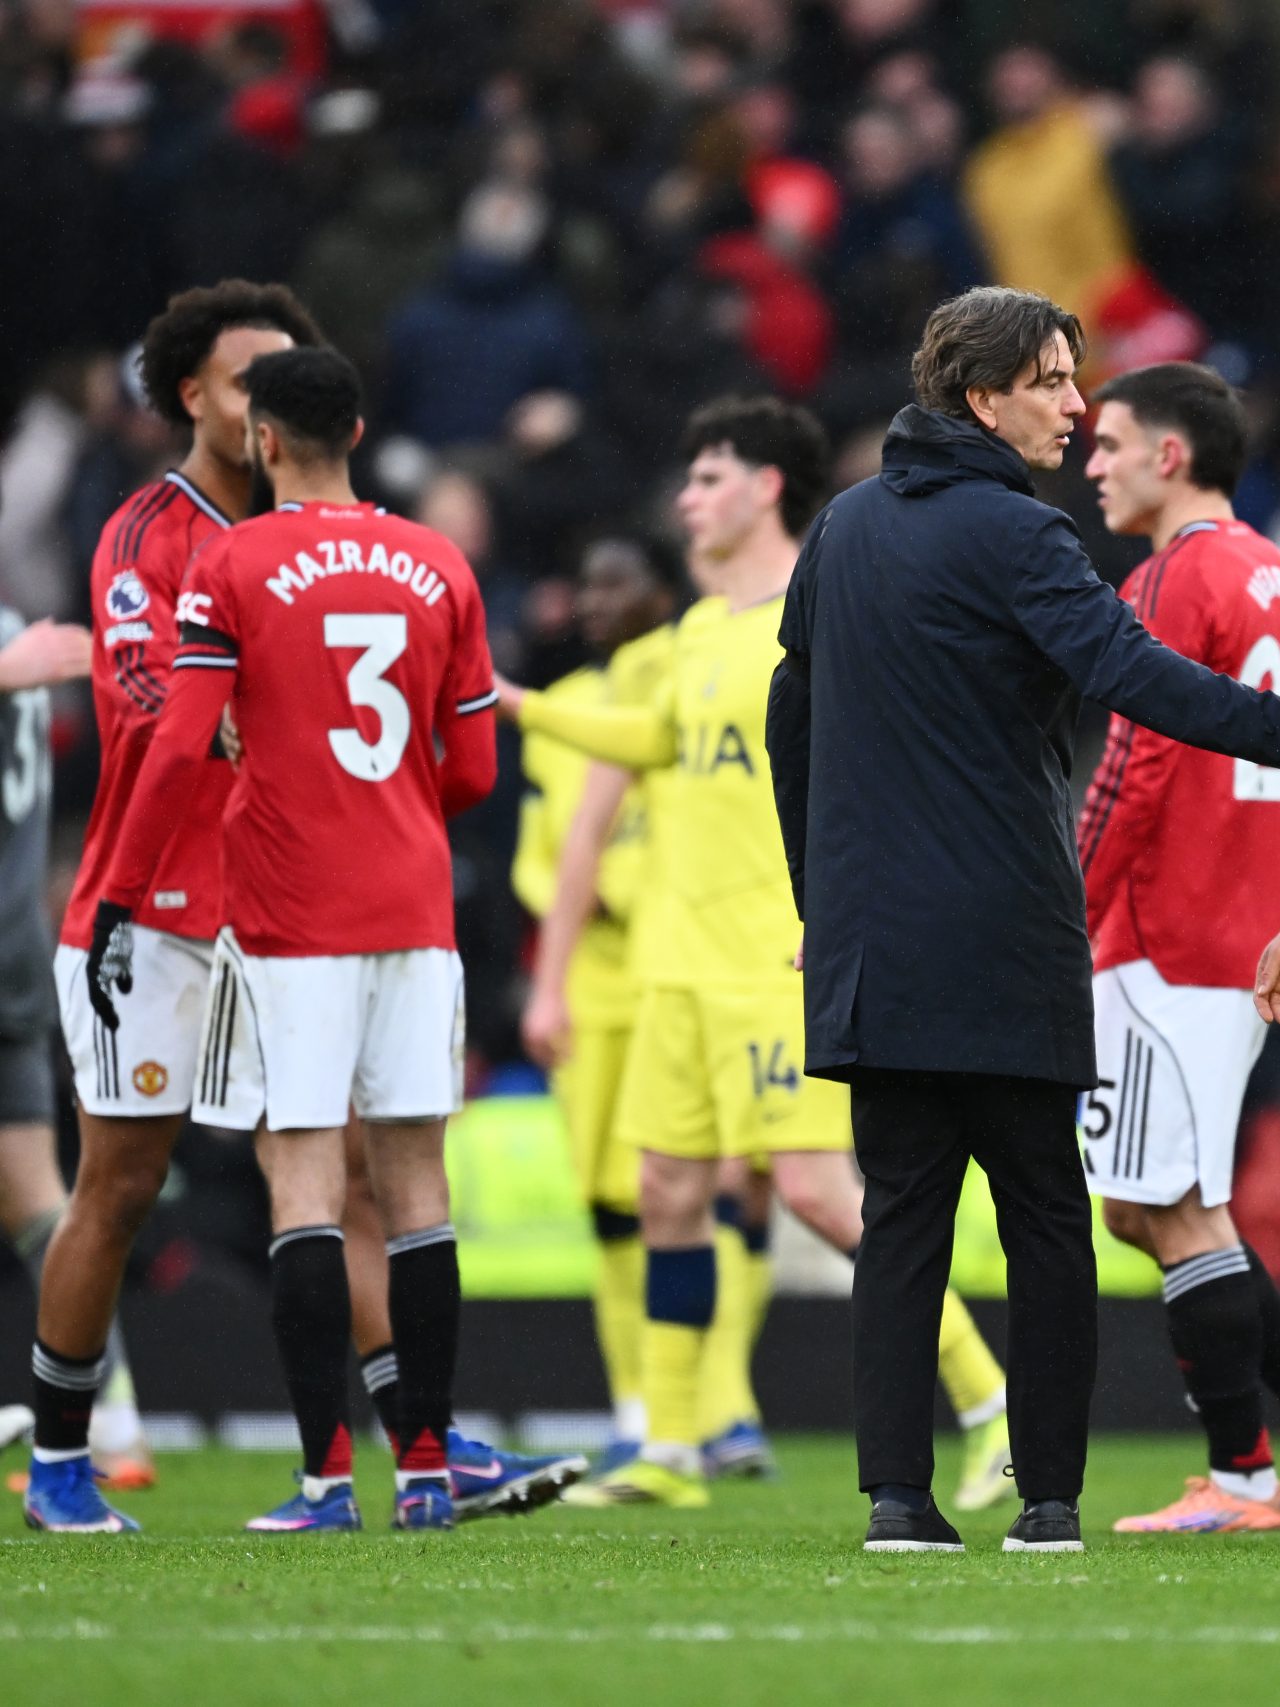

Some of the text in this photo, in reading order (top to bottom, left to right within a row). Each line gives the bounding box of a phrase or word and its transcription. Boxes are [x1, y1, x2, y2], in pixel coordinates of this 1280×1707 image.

[264, 539, 447, 606] MAZRAOUI
[322, 613, 412, 783] 3
[748, 1040, 798, 1097] 14
